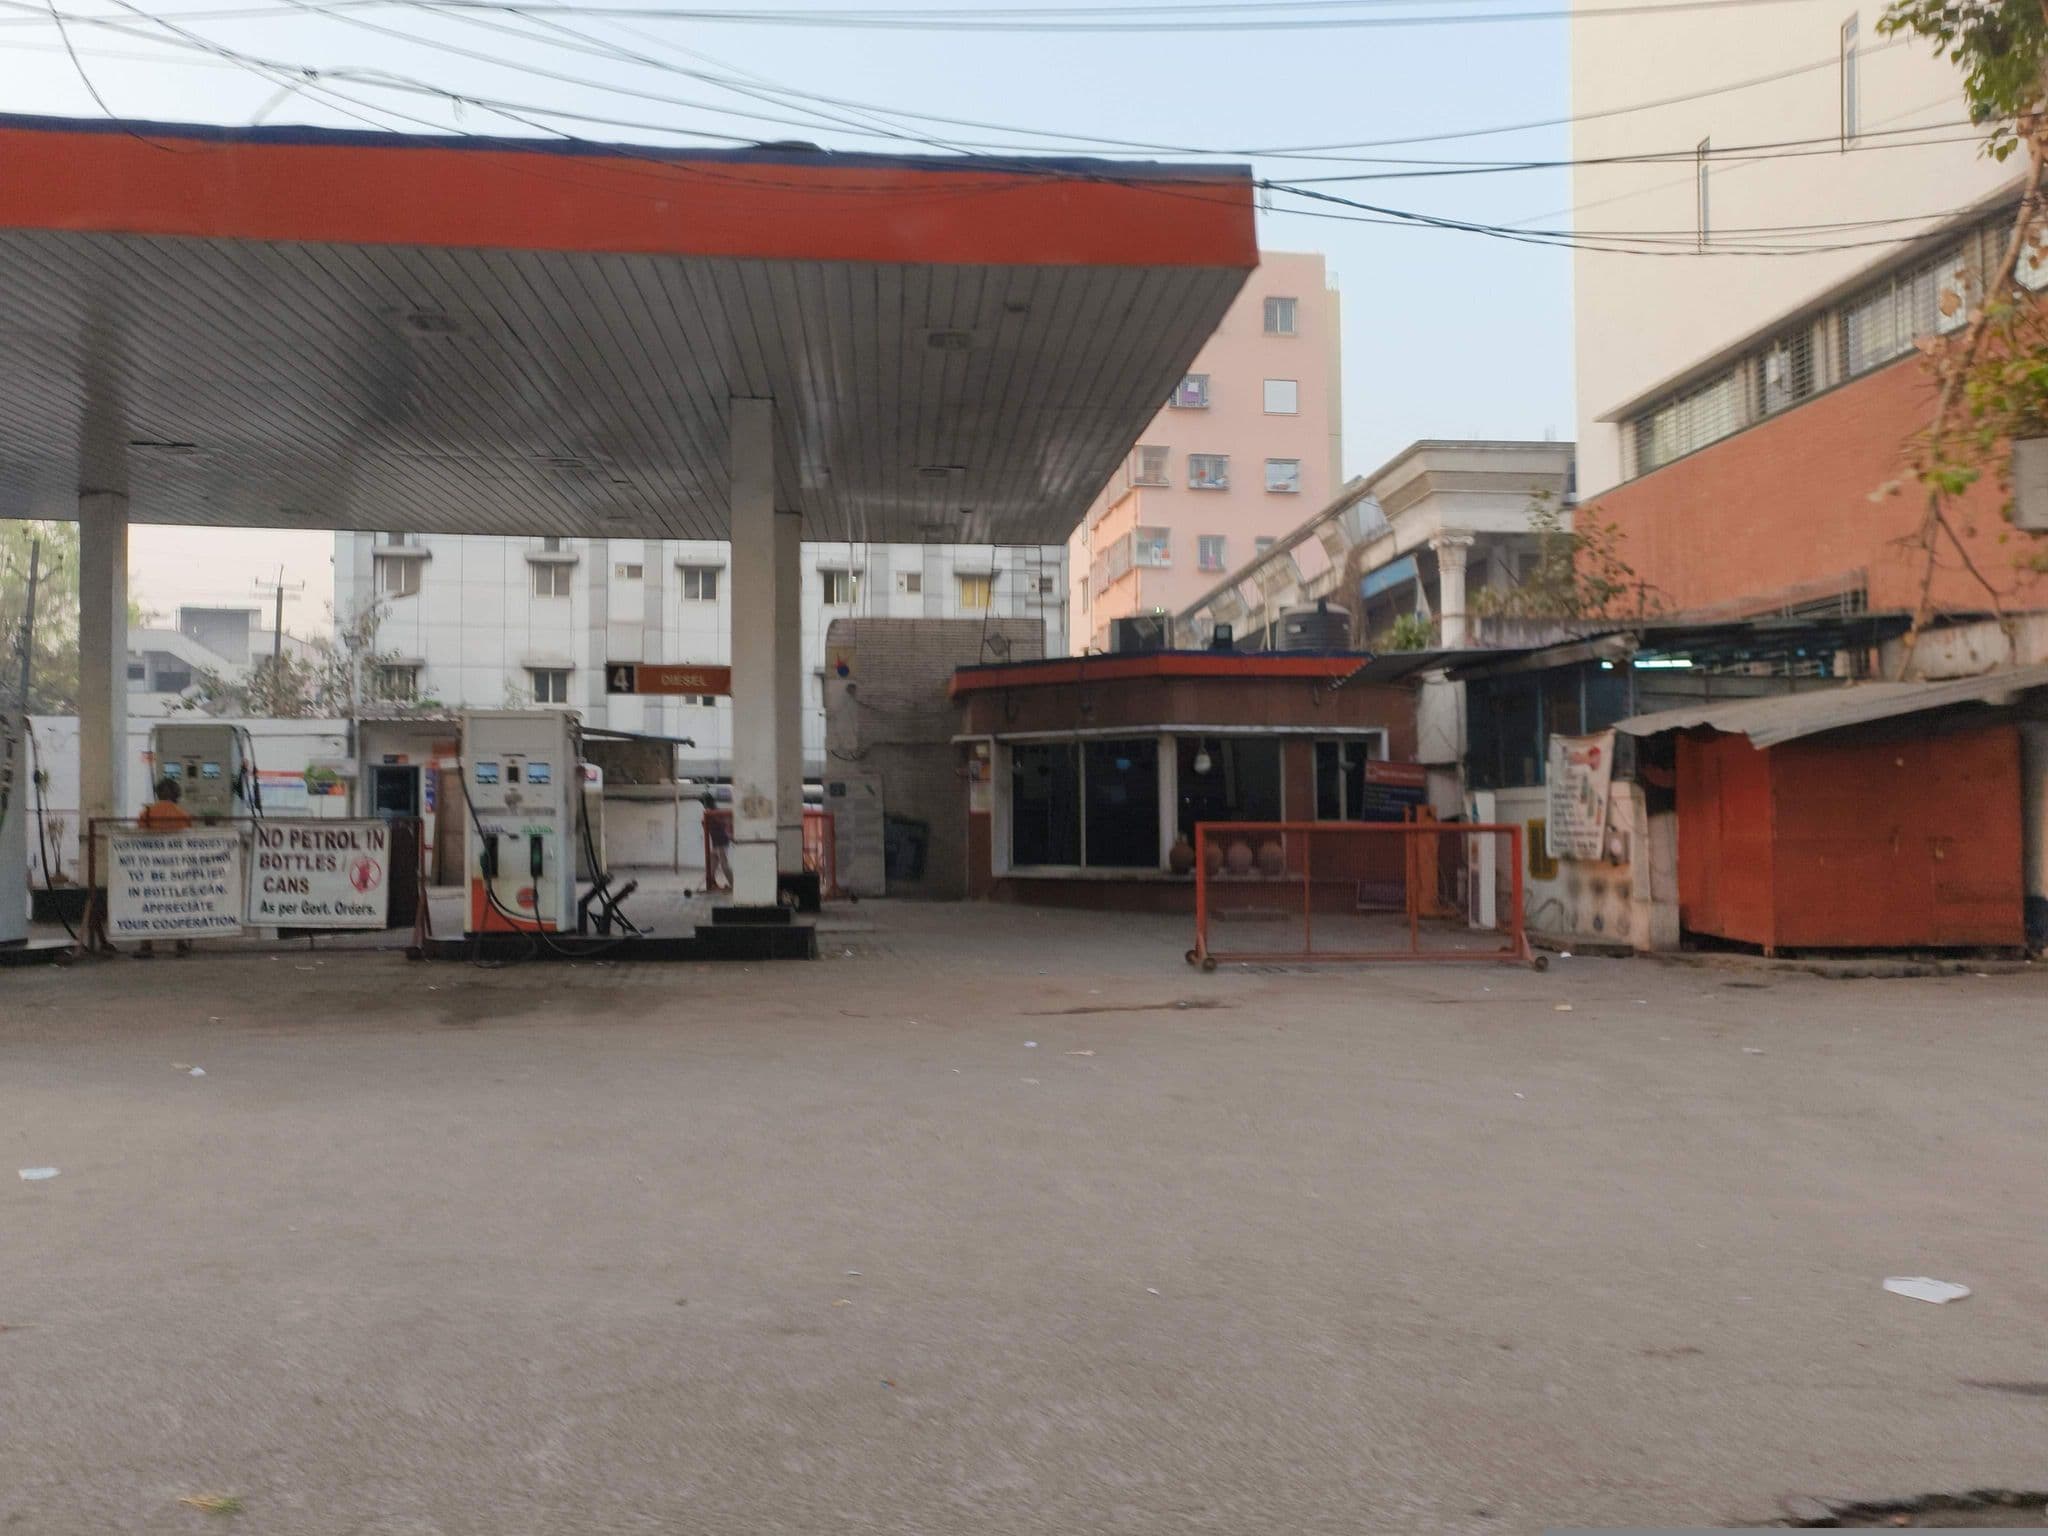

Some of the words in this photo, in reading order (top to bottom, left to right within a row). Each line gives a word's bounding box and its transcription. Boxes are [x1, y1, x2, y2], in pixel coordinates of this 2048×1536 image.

[613, 667, 629, 691] 4
[661, 673, 706, 687] DIESEL
[259, 827, 284, 849] NO
[289, 828, 361, 850] PETROL
[367, 828, 385, 851] IN
[259, 853, 337, 872] BOTTLES
[151, 870, 166, 881] BE
[128, 887, 141, 897] IN
[263, 876, 310, 895] CANS
[142, 901, 215, 914] APPRECIATE
[260, 900, 275, 914] As
[279, 902, 297, 918] per
[117, 919, 150, 930] YOUR
